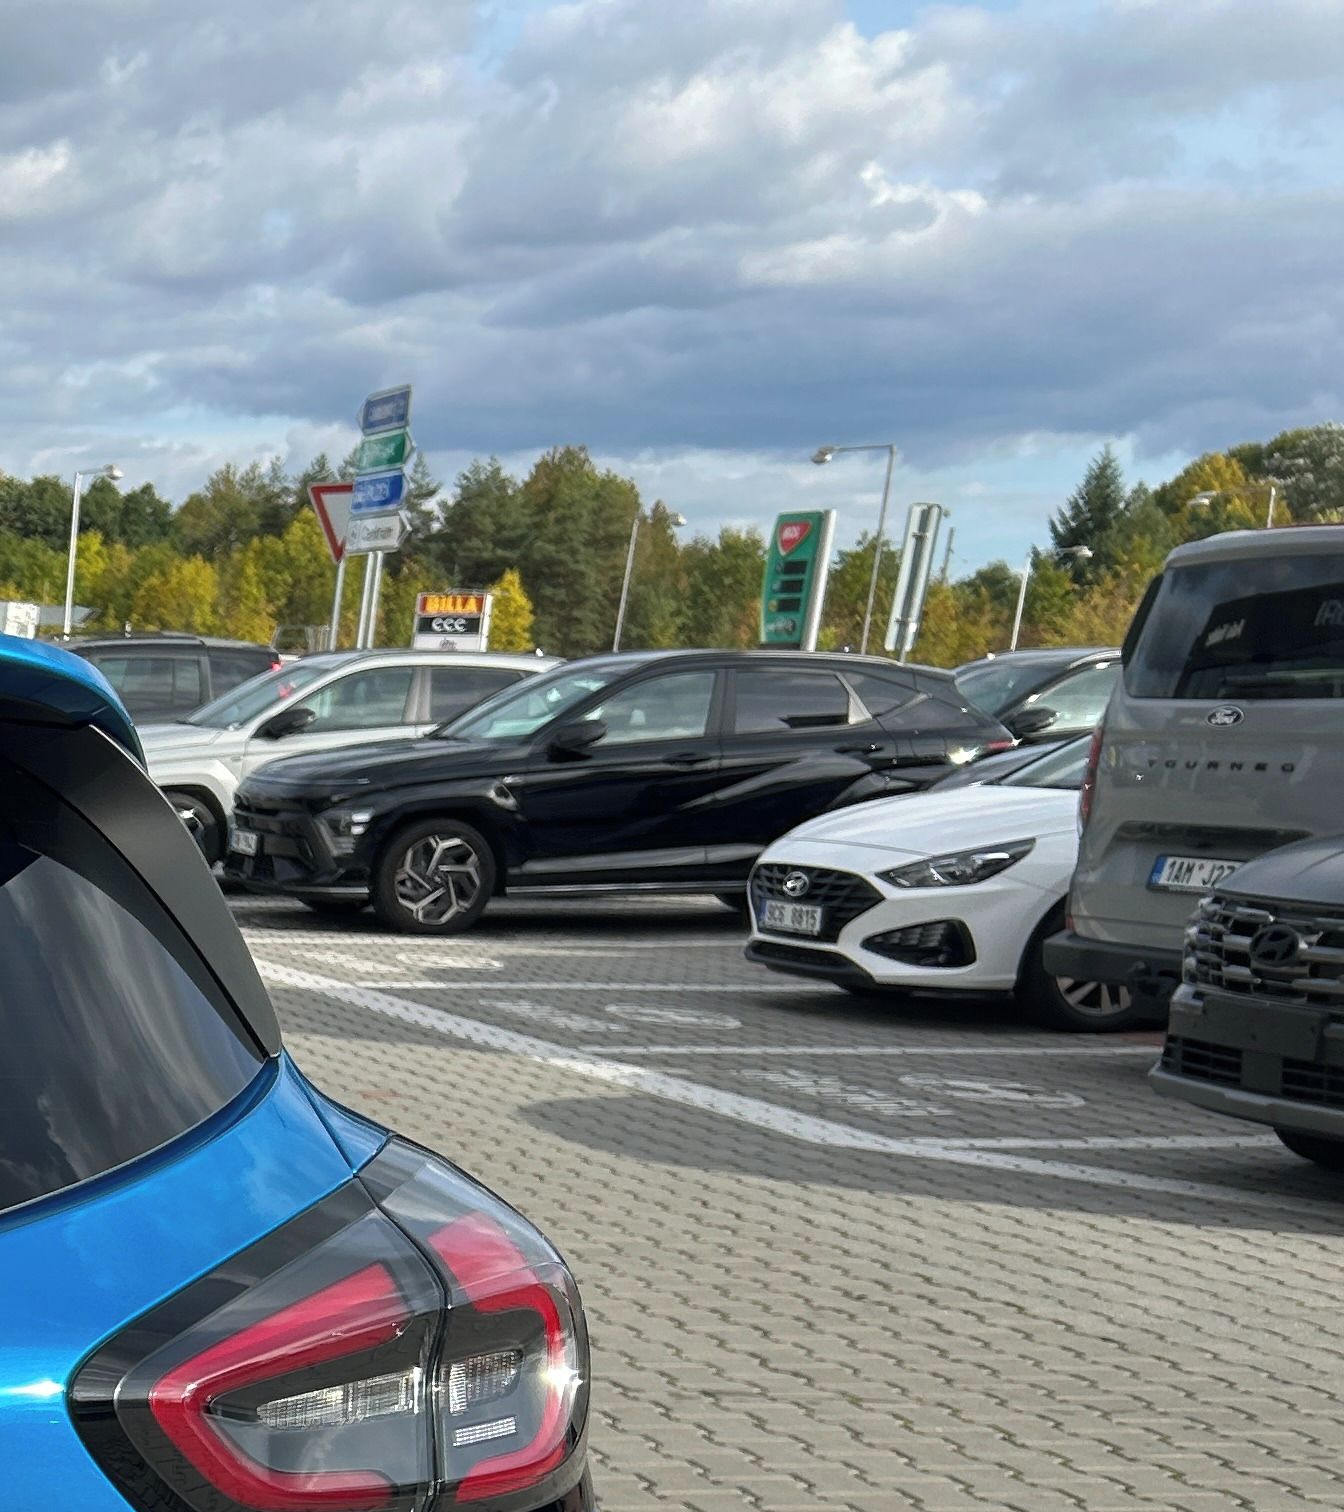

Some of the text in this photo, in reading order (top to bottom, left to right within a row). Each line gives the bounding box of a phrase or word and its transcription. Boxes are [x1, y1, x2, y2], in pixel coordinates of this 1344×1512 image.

[424, 594, 477, 614] BILLA
[1148, 759, 1295, 773] TOURNEO
[1167, 860, 1196, 884] 1AM
